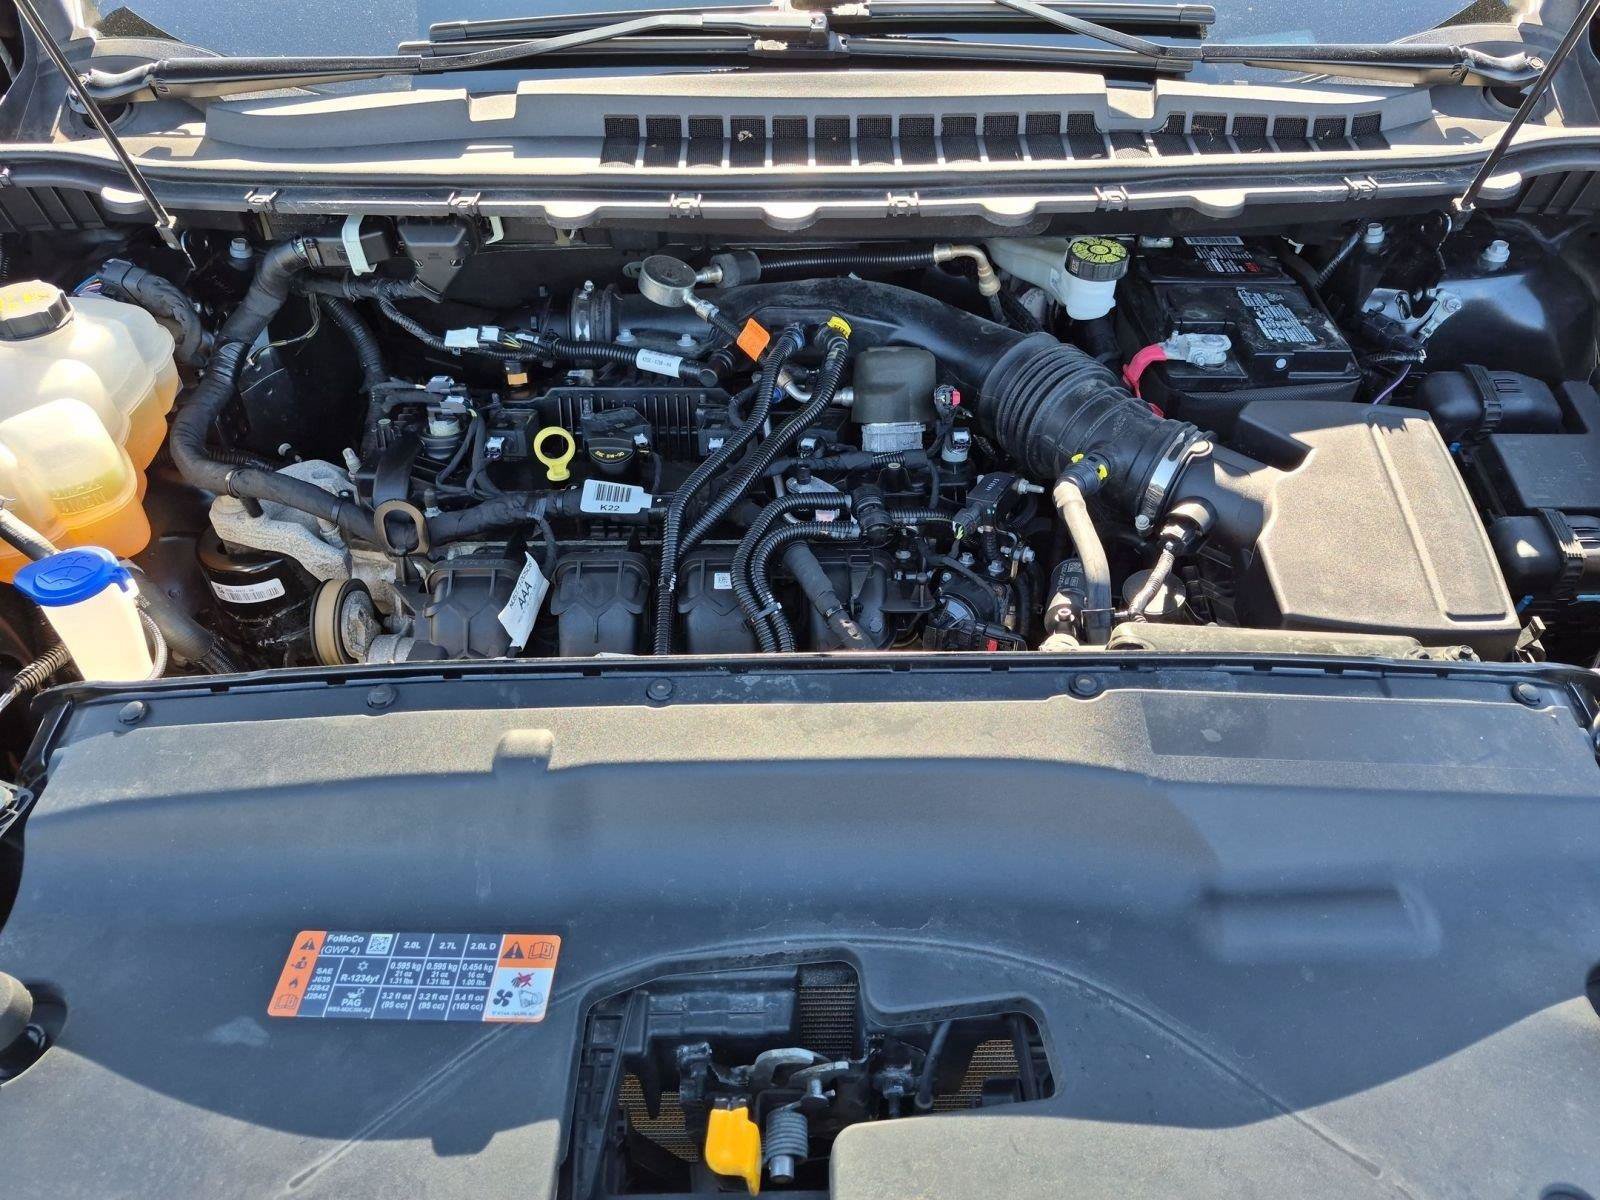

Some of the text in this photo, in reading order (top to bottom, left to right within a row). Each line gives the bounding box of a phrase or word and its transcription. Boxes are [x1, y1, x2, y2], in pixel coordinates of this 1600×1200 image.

[517, 581, 534, 610] AAA
[327, 934, 365, 943] FoMoCo
[403, 941, 421, 950] 2.0L
[440, 942, 457, 950] 2.7L
[470, 942, 497, 950] 2.0L D
[321, 946, 361, 956] (GWP 4)
[390, 962, 422, 972] 0.595 kg
[426, 962, 458, 972] 0.595 kg
[462, 963, 494, 973] 0.454 kg
[340, 974, 380, 984] R-1234yf
[394, 992, 402, 1000] fl
[341, 999, 362, 1007] PAG
[382, 1000, 408, 1010] (95 cc)
[418, 1001, 446, 1010] (95 cc)
[452, 1002, 484, 1012] (160 cc)
